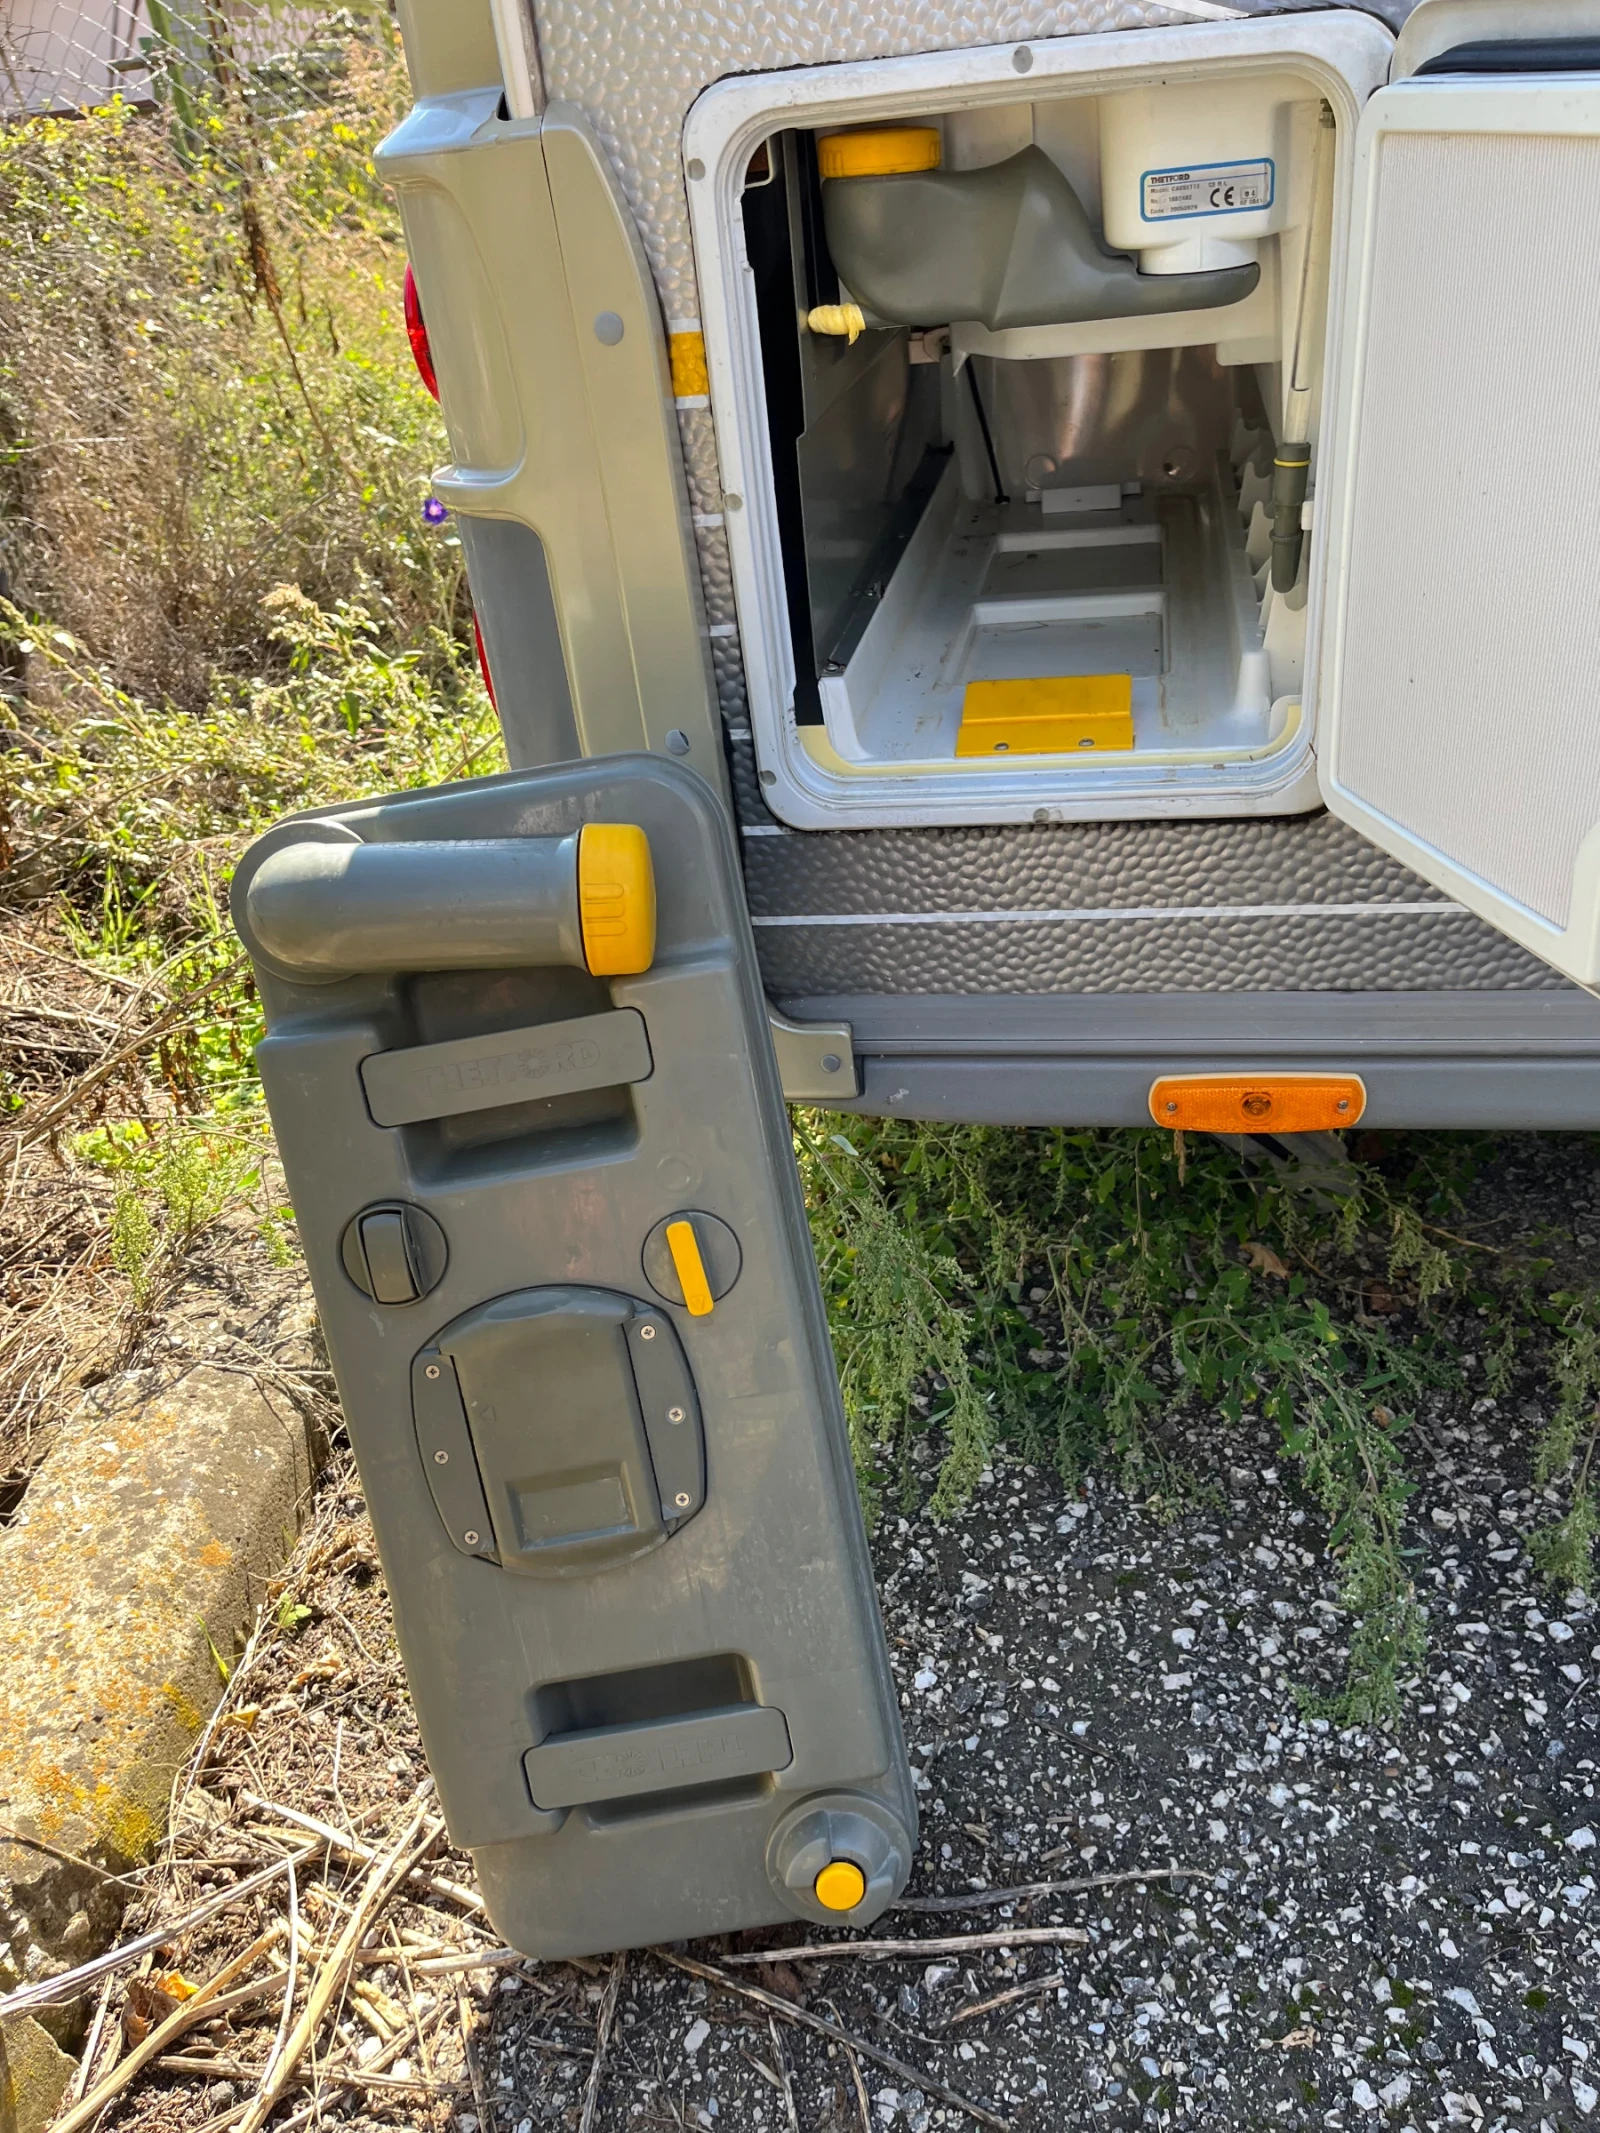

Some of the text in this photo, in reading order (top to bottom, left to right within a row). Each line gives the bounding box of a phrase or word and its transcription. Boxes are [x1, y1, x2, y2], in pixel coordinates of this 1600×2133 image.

[1150, 173, 1190, 184] THETFORD
[1171, 184, 1200, 192] CASSETTE
[412, 1038, 602, 1097] THETFORD
